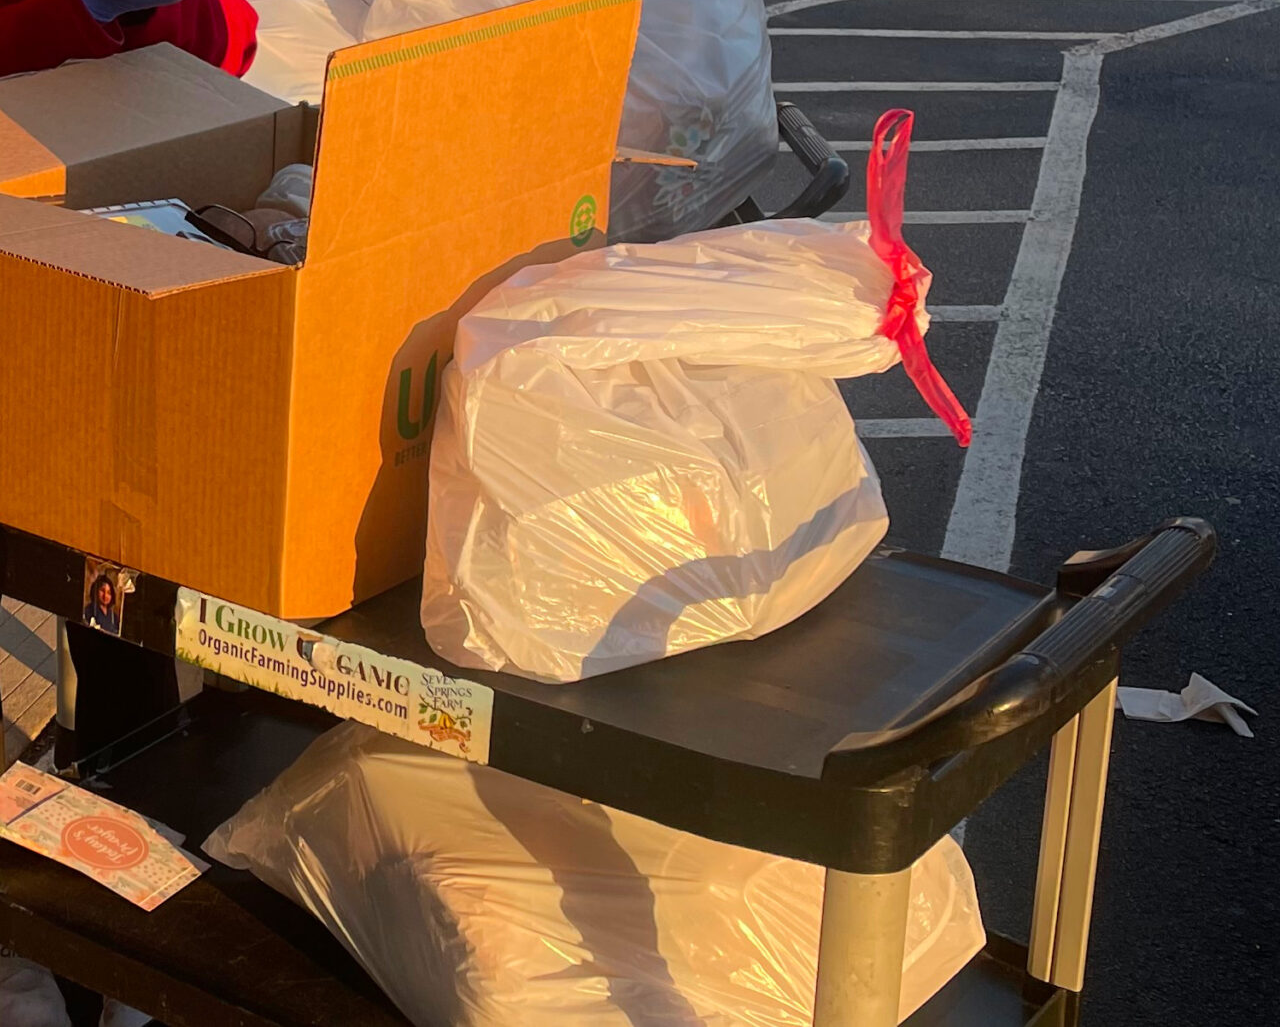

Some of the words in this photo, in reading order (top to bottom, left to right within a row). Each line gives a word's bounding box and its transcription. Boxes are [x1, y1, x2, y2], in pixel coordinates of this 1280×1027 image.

[199, 597, 208, 624] I
[215, 604, 289, 652] GROW
[296, 636, 410, 696] GANIC
[198, 628, 408, 720] OrganicFarmingSupplies.com
[421, 673, 457, 686] SEVEN
[426, 685, 473, 699] SPRINGS
[432, 697, 463, 711] FARM
[72, 829, 125, 864] Today's
[87, 824, 139, 856] Prayer
